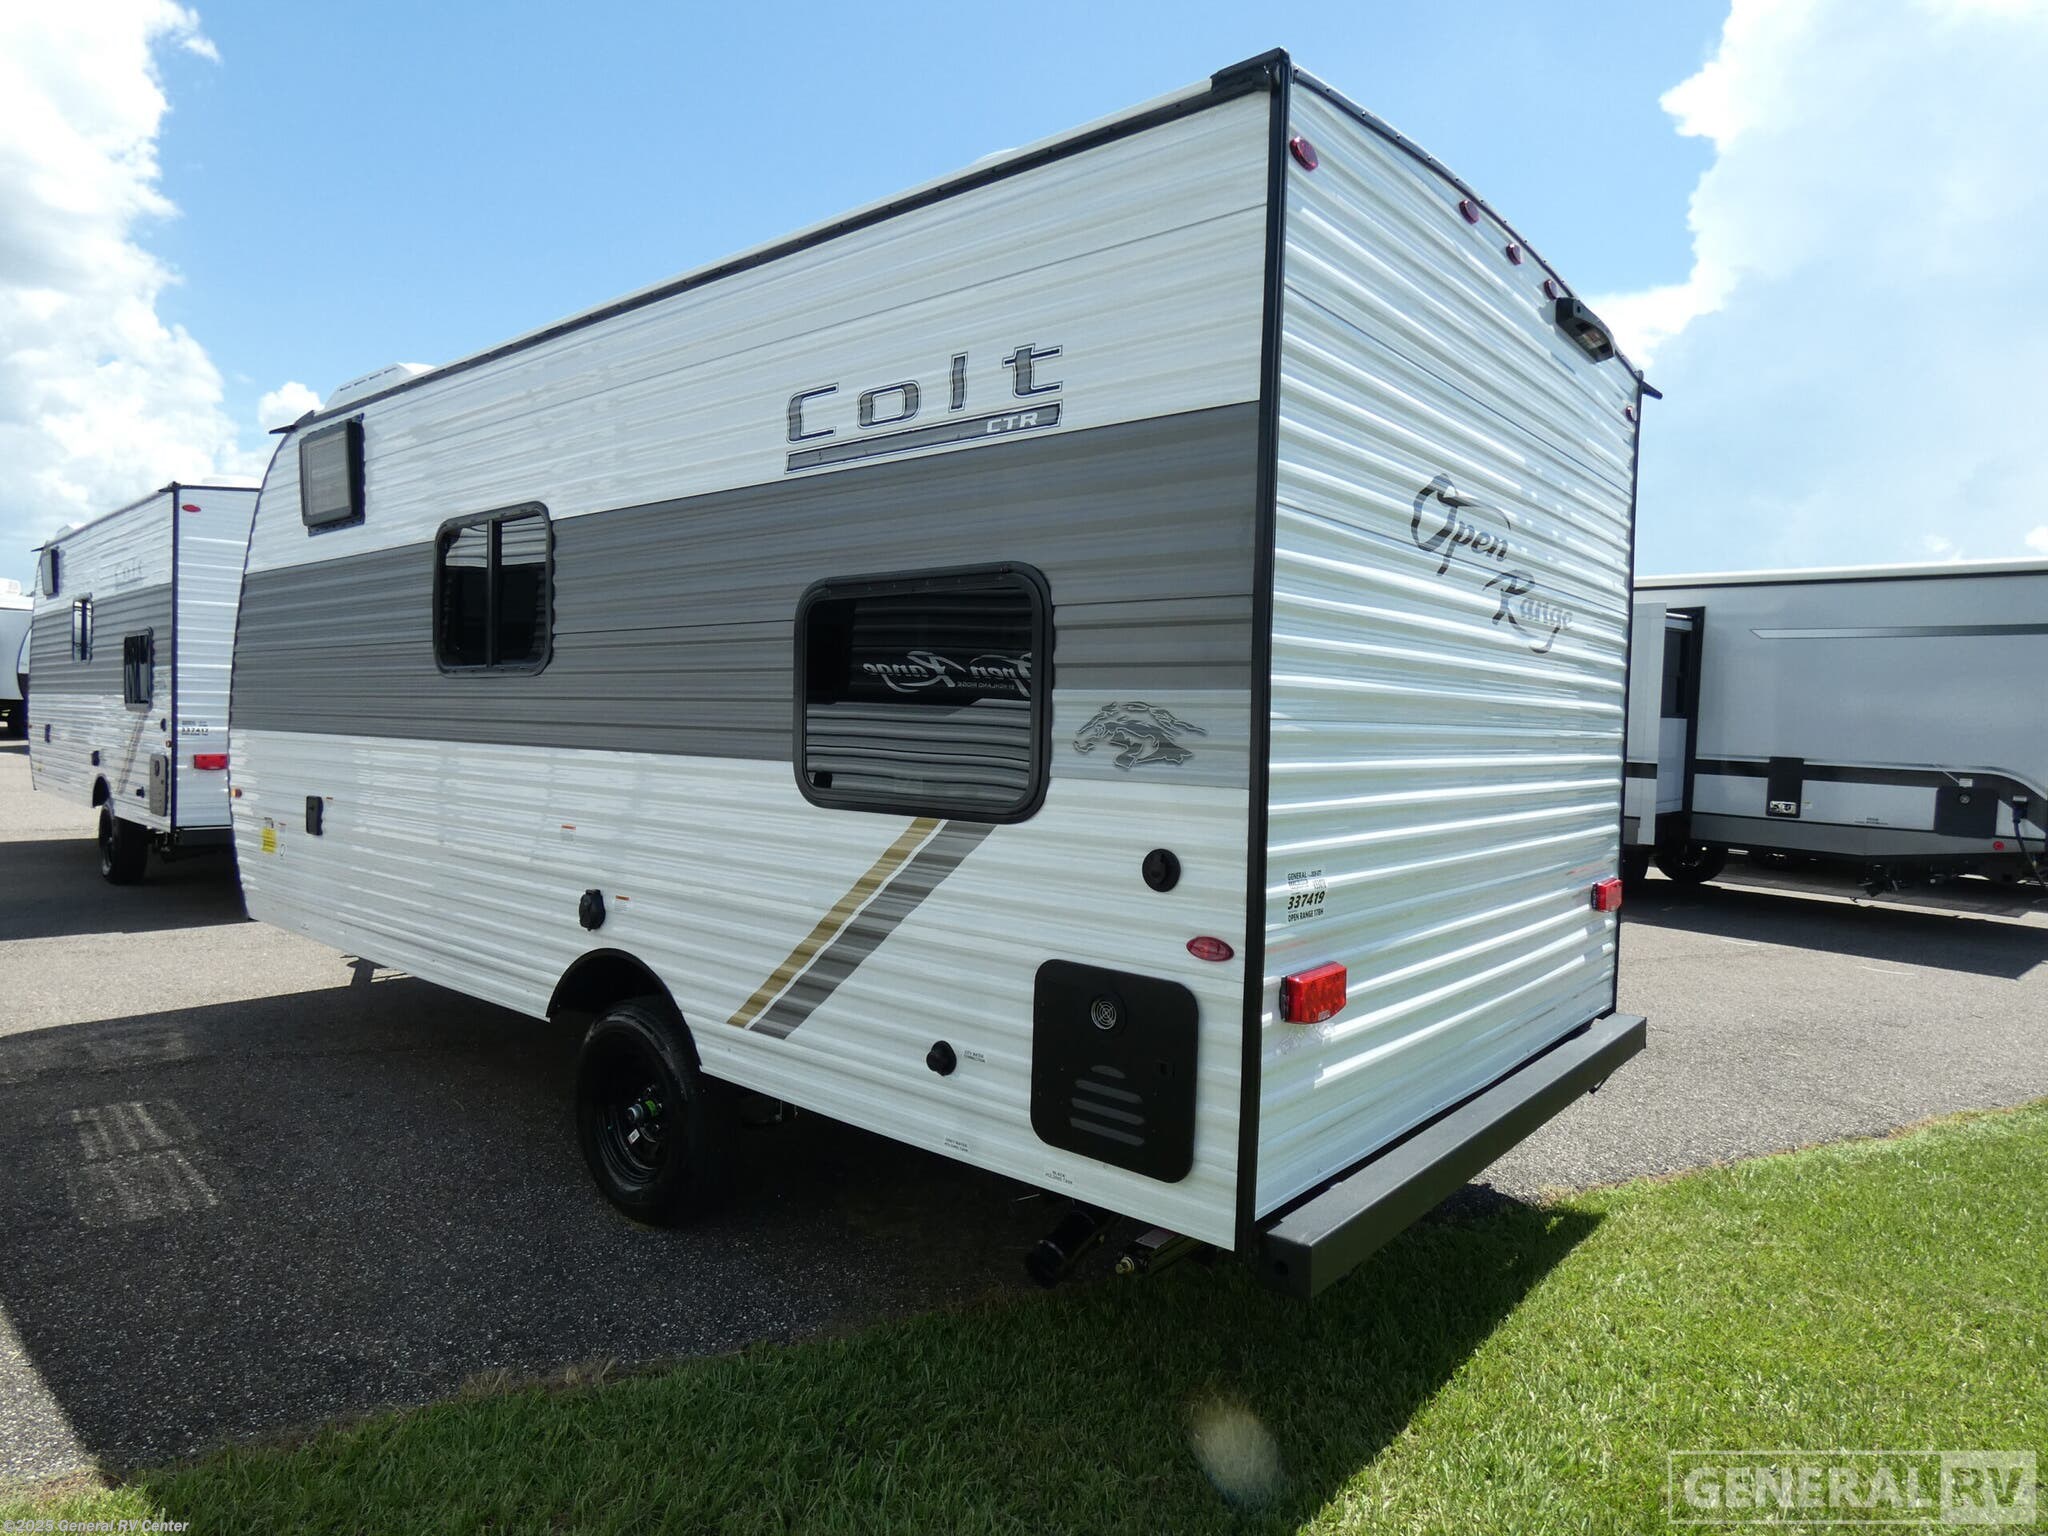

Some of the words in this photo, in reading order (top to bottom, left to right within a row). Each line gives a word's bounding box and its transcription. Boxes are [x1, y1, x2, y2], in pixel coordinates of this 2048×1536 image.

[786, 343, 1063, 444] Colt
[986, 412, 1038, 433] CTR
[1411, 473, 1511, 576] Open
[1483, 569, 1574, 653] Range
[1287, 871, 1308, 881] GENERAL
[1287, 891, 1326, 910] 337419
[1288, 912, 1300, 922] OPEN
[1300, 910, 1314, 920] RANGE
